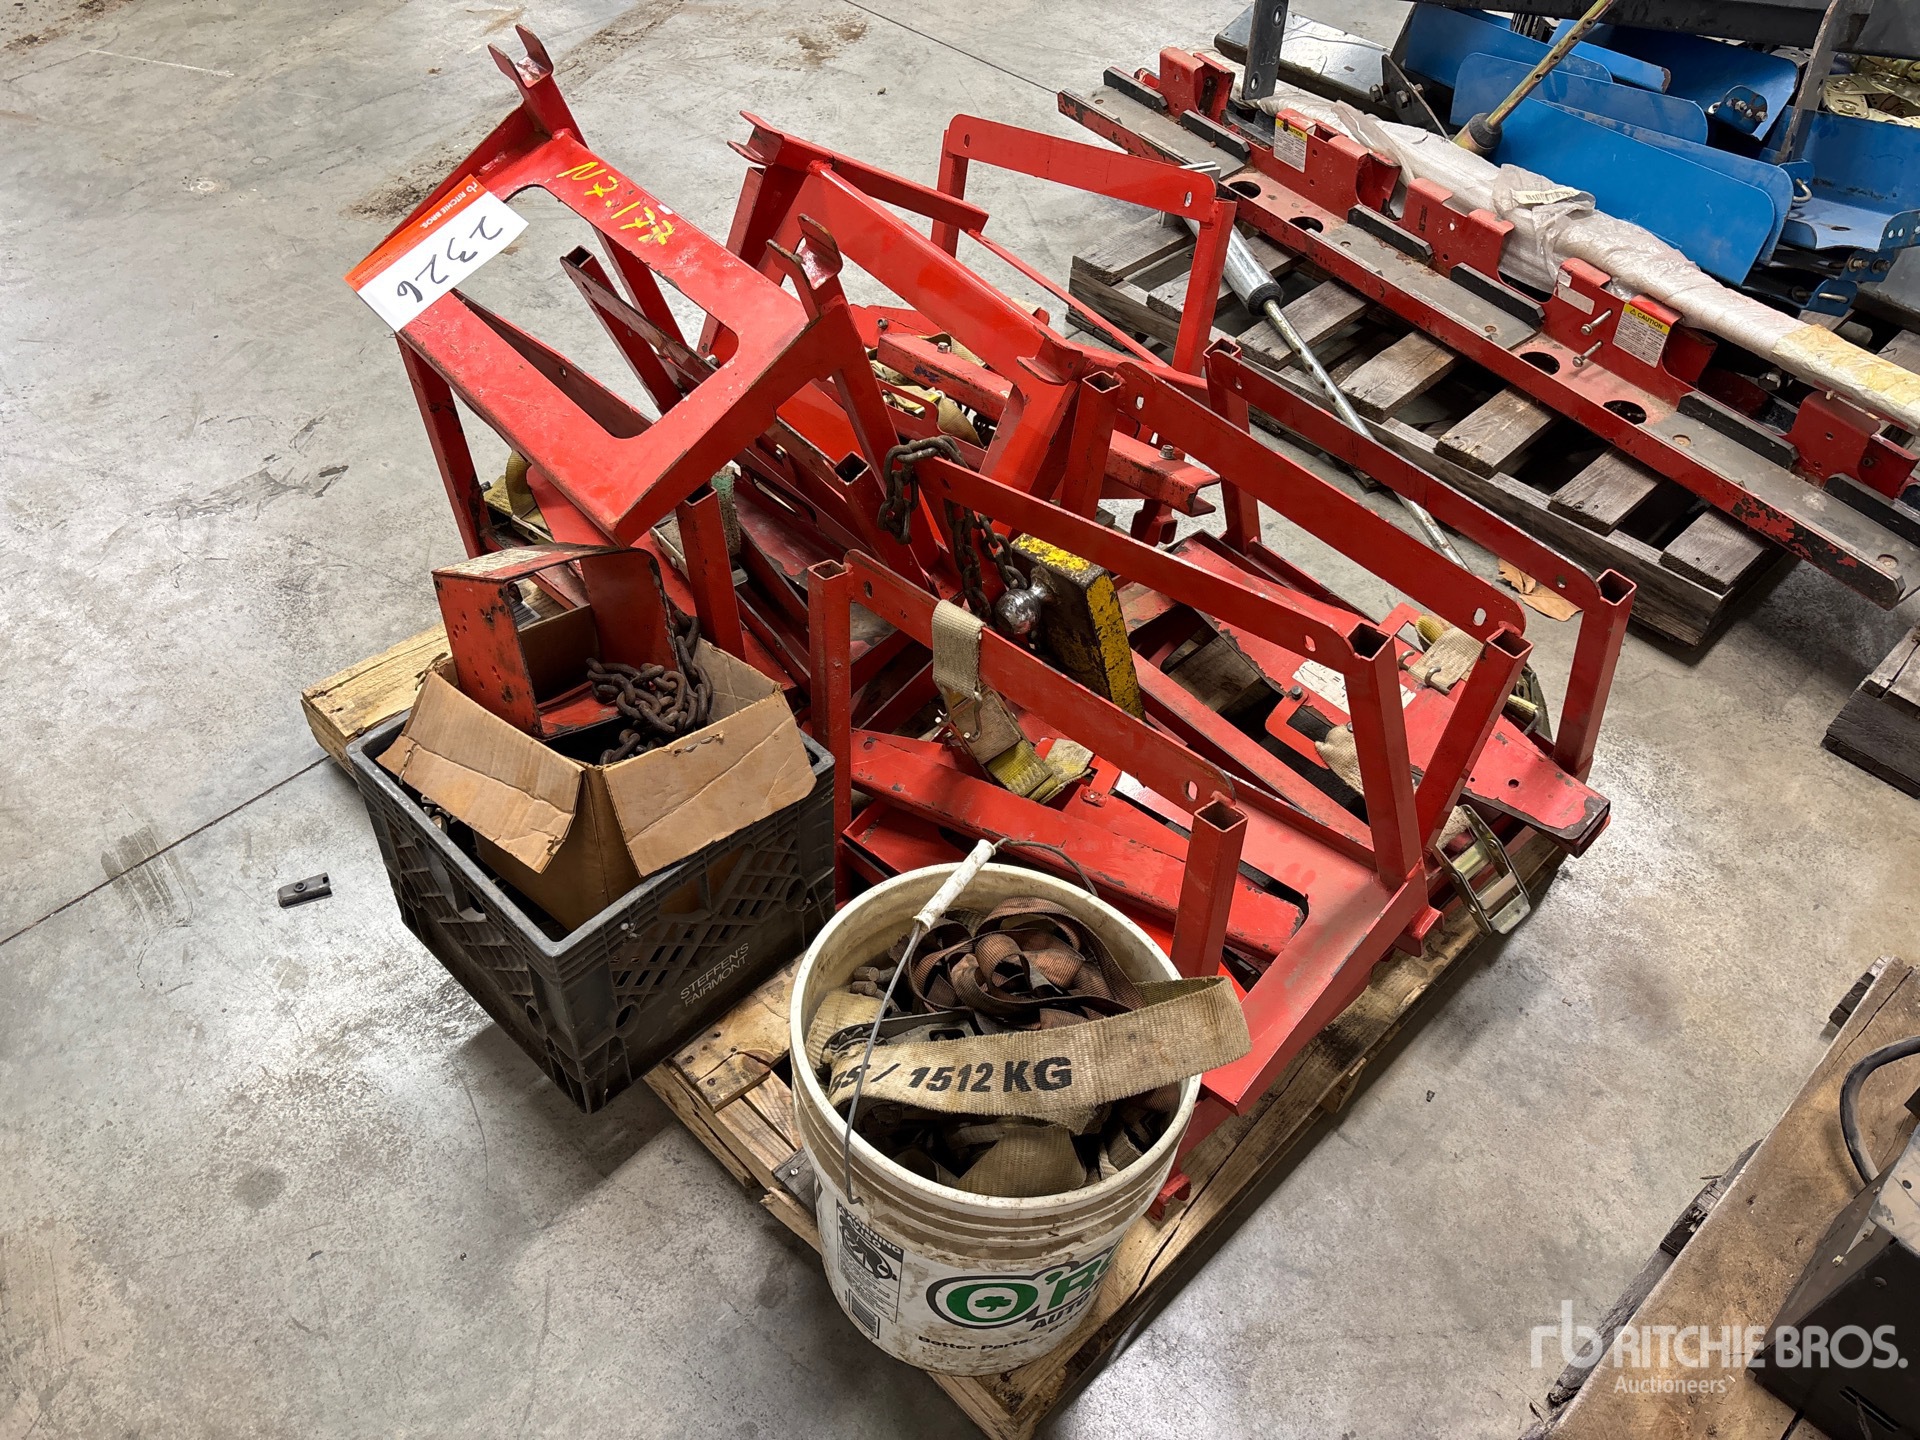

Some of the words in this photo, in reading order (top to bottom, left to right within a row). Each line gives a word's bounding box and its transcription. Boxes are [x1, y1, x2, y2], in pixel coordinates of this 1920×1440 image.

[440, 191, 467, 214] RITCHIE
[420, 211, 442, 229] BROS.
[396, 215, 504, 304] 2326
[1637, 312, 1664, 330] CAUTION
[680, 942, 749, 1000] STEFFEN'S
[684, 953, 748, 1007] FAIRMONT
[908, 1062, 995, 1093] 1512
[1003, 1056, 1073, 1093] KG
[918, 1335, 976, 1350] Better
